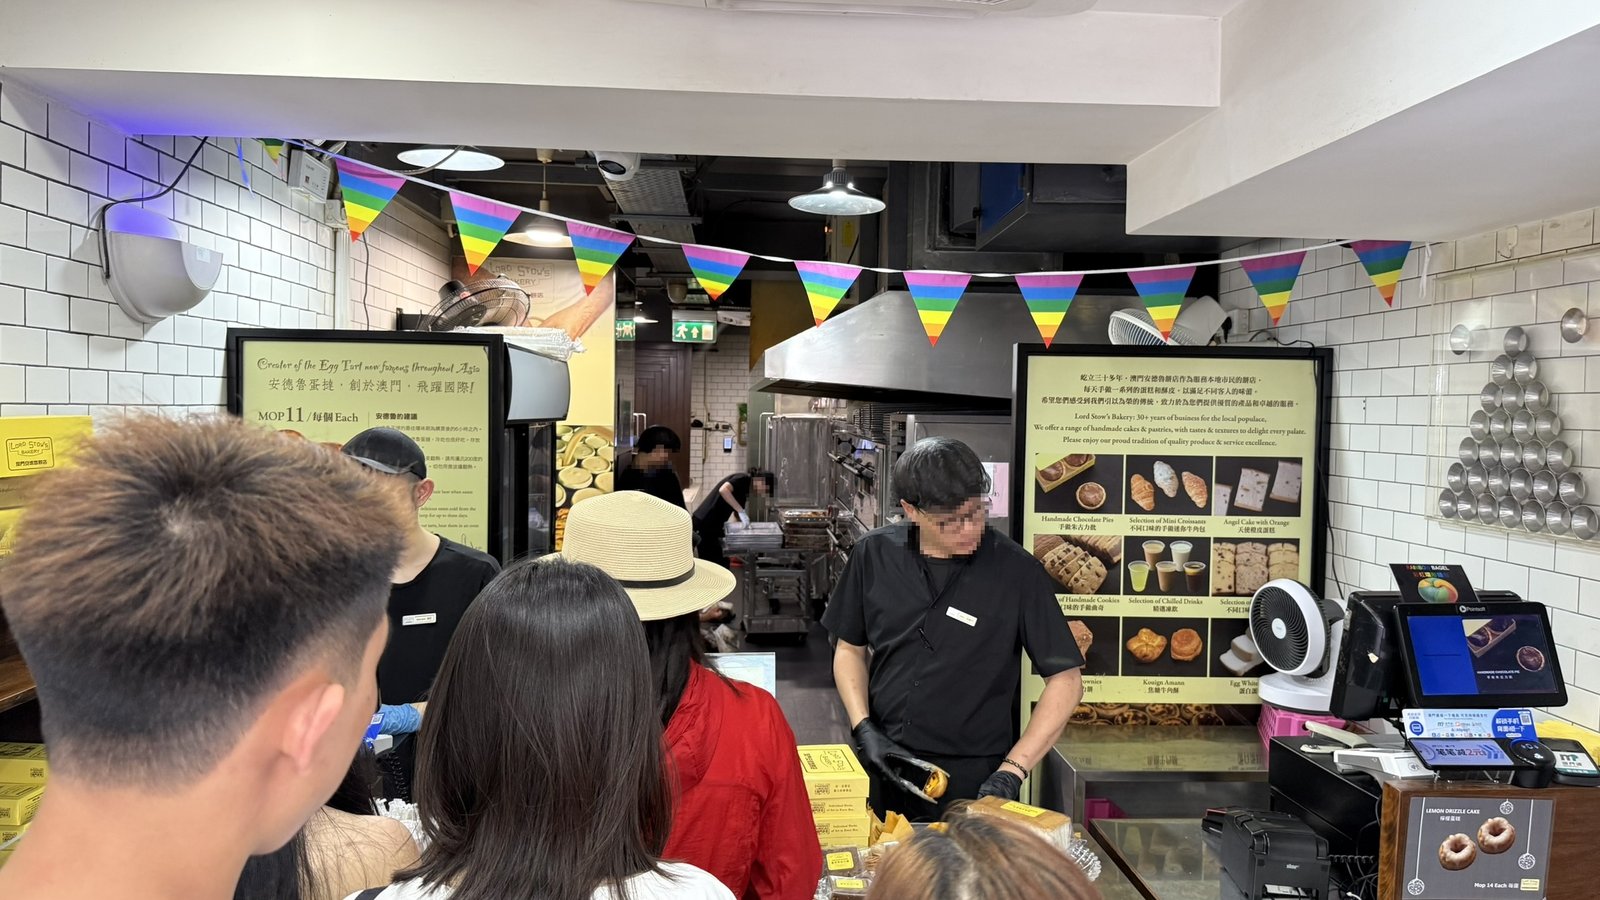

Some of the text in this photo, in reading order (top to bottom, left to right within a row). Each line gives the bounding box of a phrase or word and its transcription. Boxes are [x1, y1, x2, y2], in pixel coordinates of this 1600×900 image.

[257, 358, 292, 370] Creator
[294, 359, 303, 372] of
[304, 360, 316, 370] the
[319, 360, 339, 374] Egg
[342, 360, 362, 371] Tart
[380, 360, 409, 374] famous
[412, 362, 454, 375] throughout
[456, 362, 480, 374] Asia
[258, 412, 285, 420] MOP
[286, 406, 304, 422] 11
[335, 412, 359, 422] Each
[1111, 413, 1135, 422] Bakery:
[1247, 427, 1268, 436] delight
[1286, 428, 1306, 436] palate.
[1082, 437, 1099, 445] enjoy
[1112, 437, 1130, 445] proud
[1168, 438, 1189, 446] quality
[1190, 438, 1215, 447] produce
[1223, 519, 1240, 527] Angel
[1230, 680, 1240, 688] Egg
